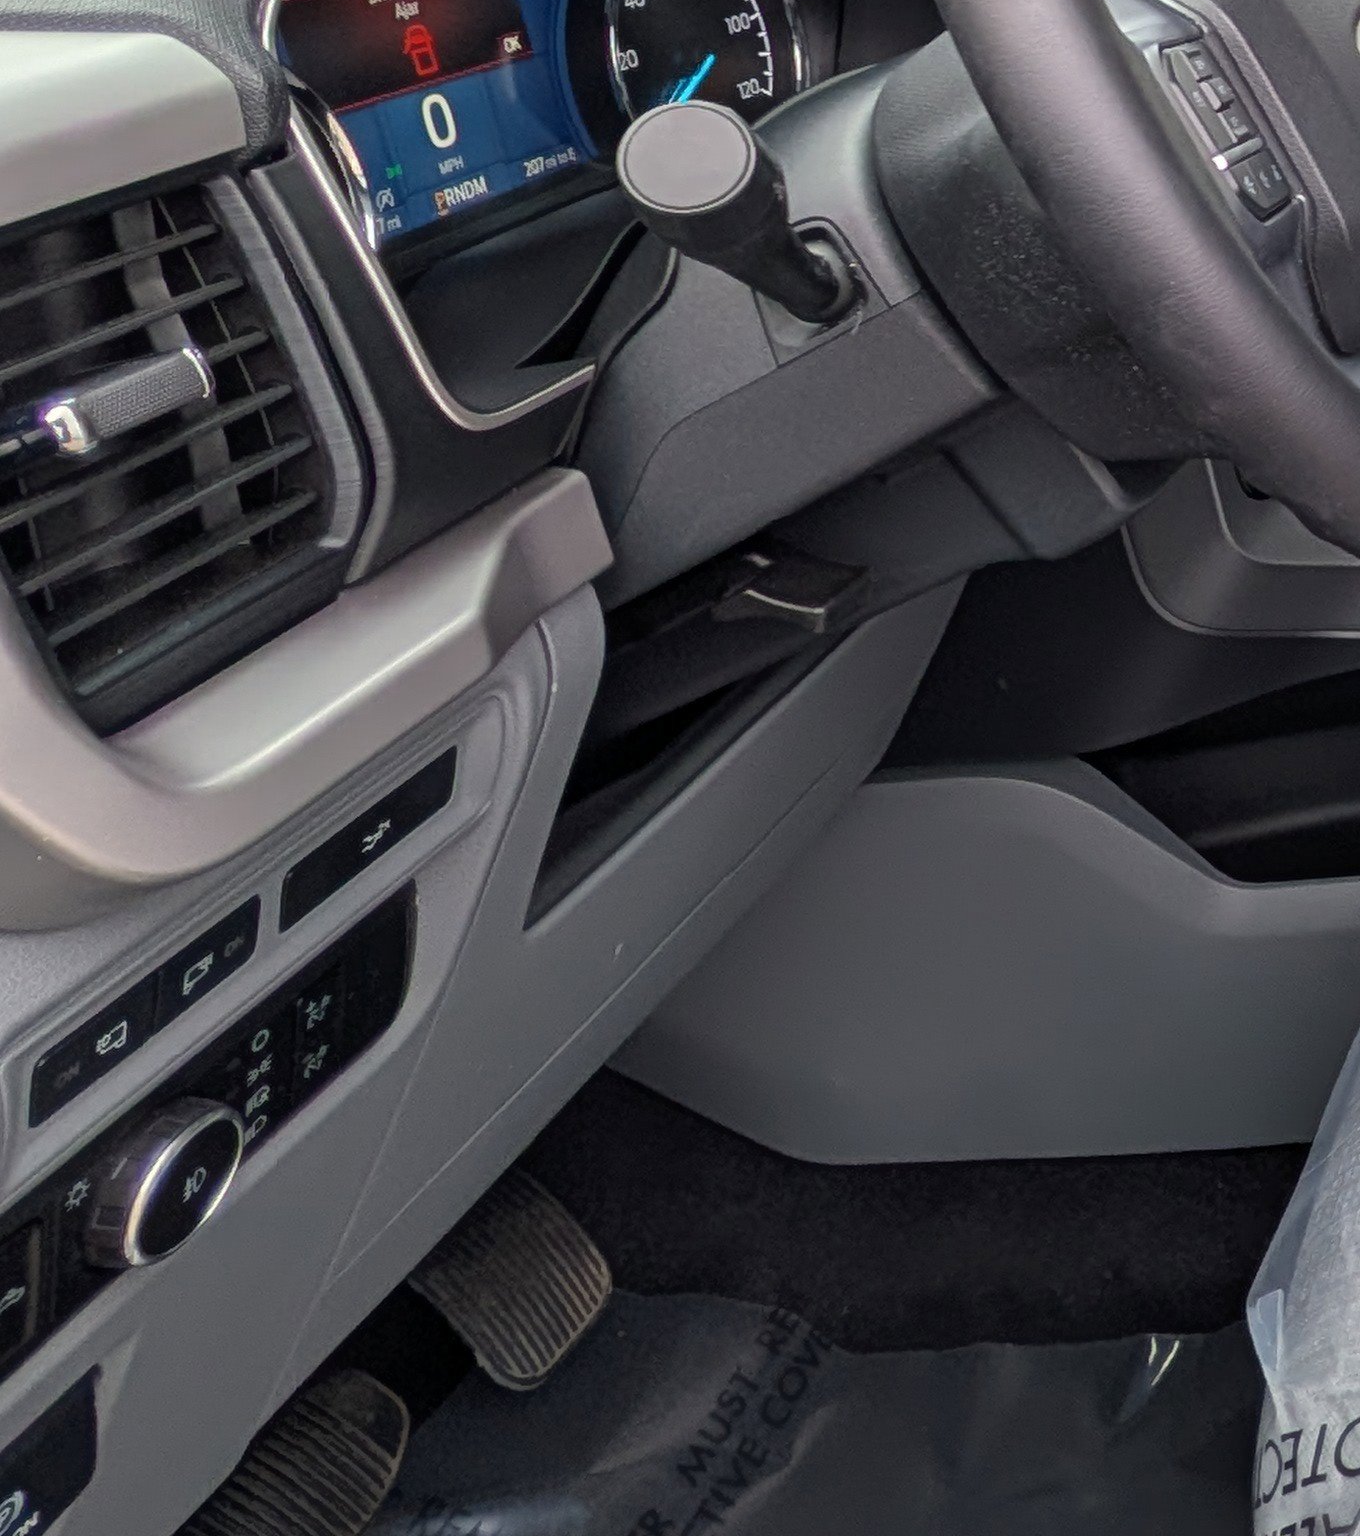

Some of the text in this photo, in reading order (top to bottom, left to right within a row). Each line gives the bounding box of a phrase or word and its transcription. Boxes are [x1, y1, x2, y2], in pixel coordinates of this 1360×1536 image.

[395, 1, 420, 20] Ajar
[724, 12, 751, 35] 100
[503, 35, 522, 53] OK
[617, 49, 639, 71] 20
[736, 78, 760, 100] 120
[421, 93, 458, 149] 0
[438, 156, 464, 175] MPH
[433, 175, 489, 215] PRNDM
